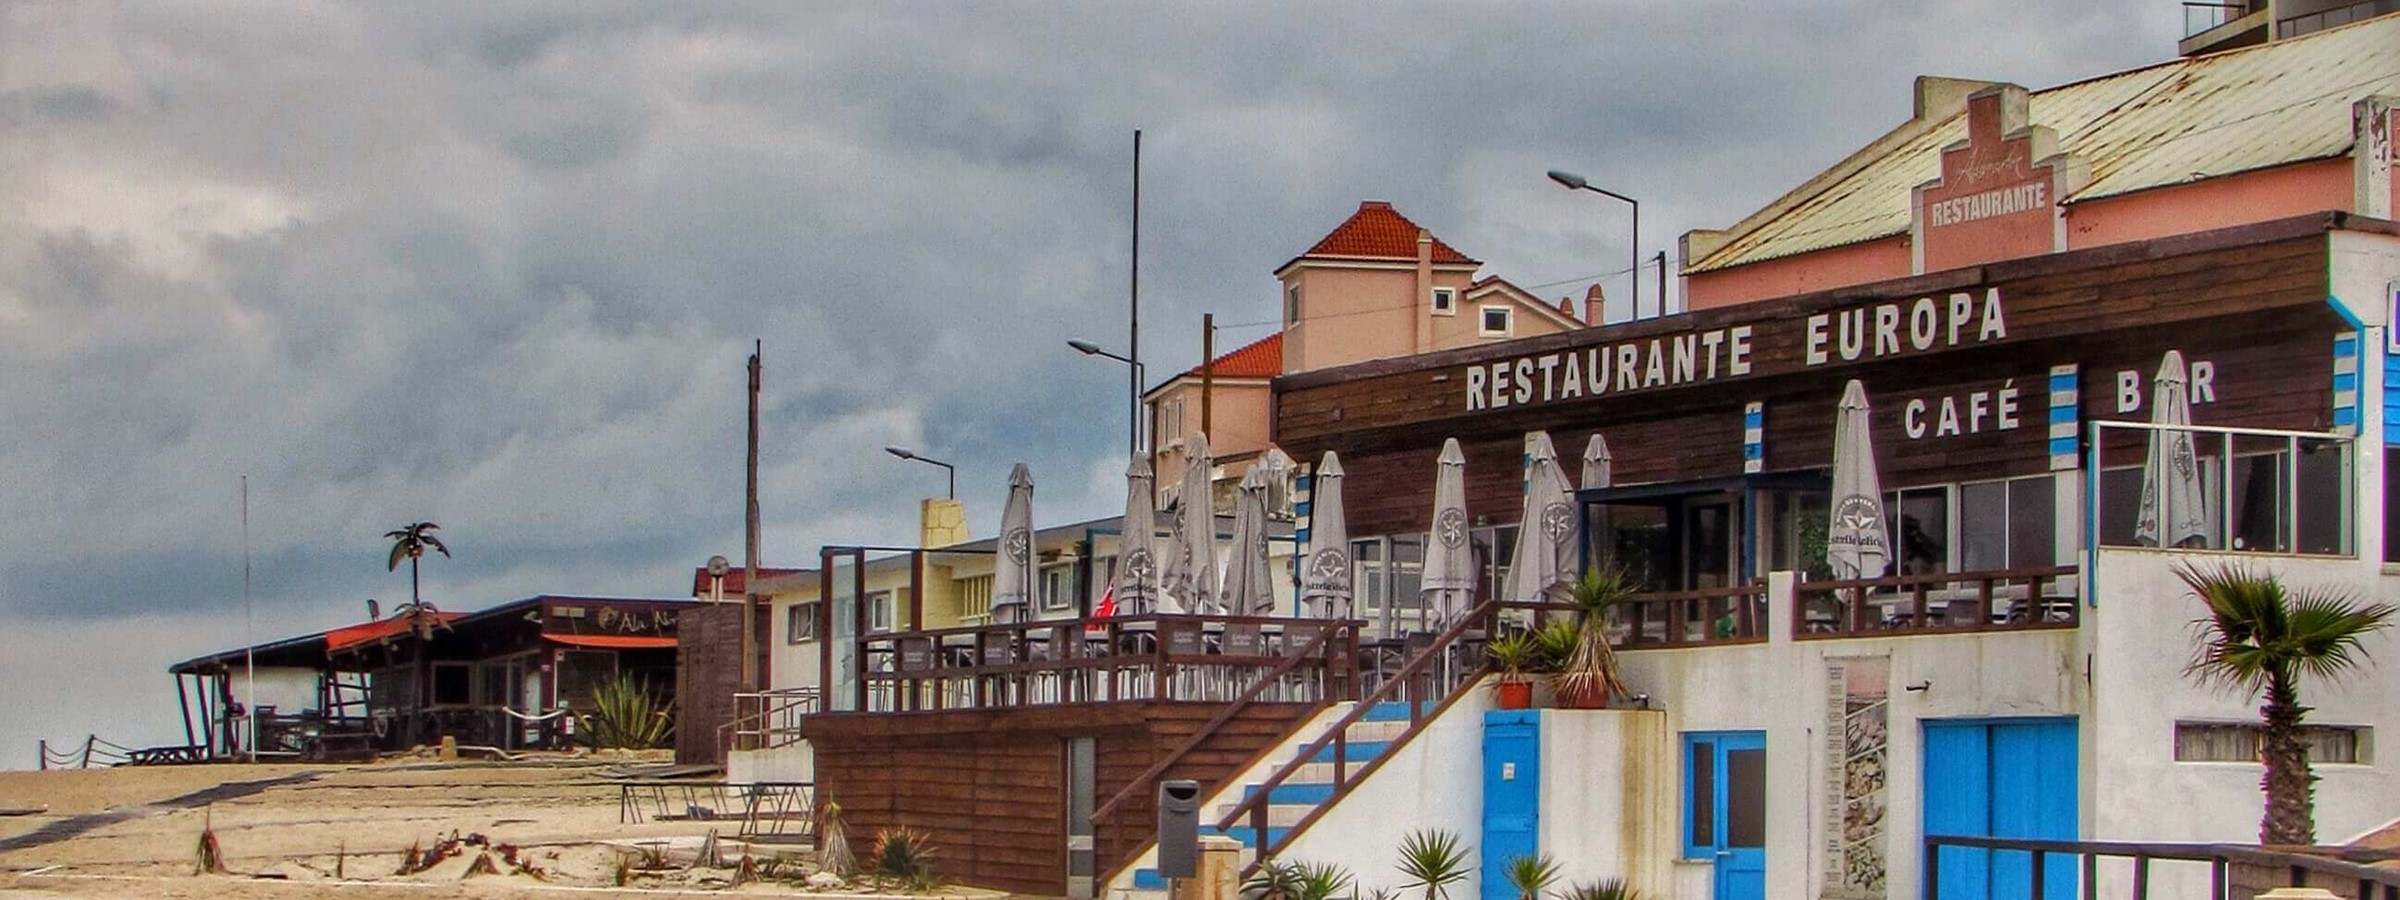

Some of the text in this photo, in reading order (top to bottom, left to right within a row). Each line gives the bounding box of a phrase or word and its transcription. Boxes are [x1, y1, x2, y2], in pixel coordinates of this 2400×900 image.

[1932, 182, 2046, 227] RESTAURANTE
[1465, 287, 2007, 412] RESTAURANTE EUROPA
[1904, 360, 2217, 440] CAFÉ BR
